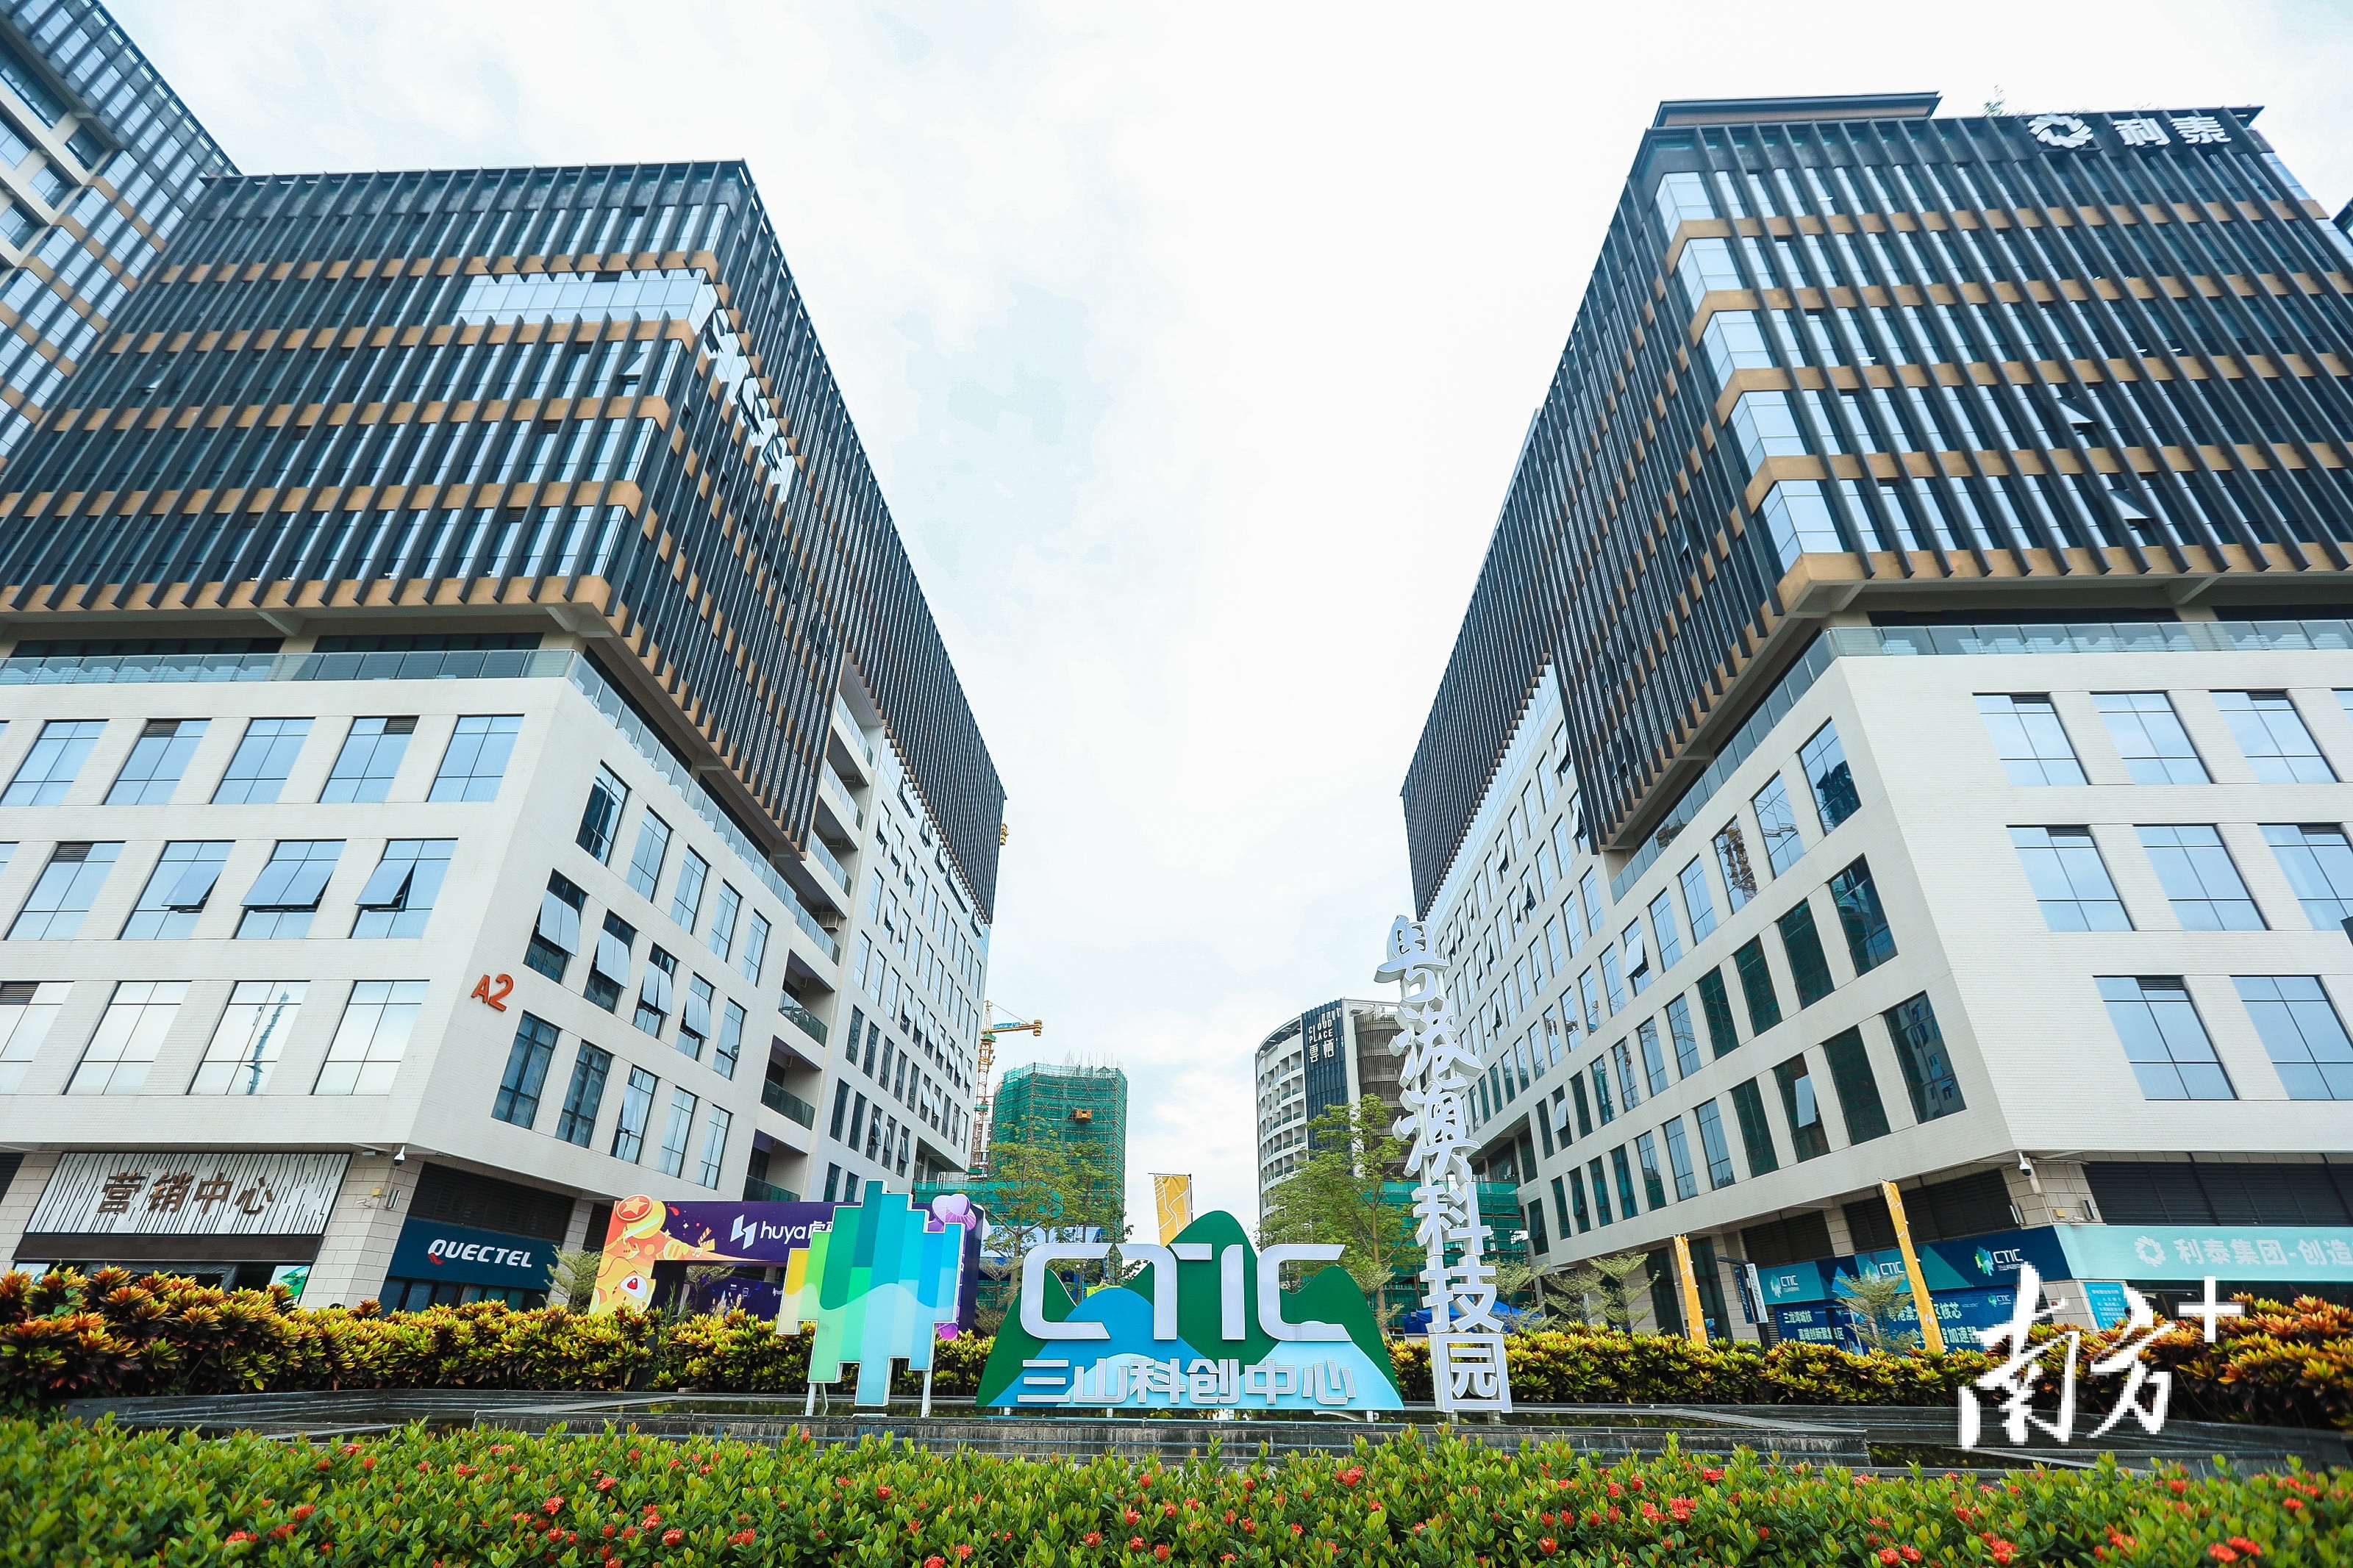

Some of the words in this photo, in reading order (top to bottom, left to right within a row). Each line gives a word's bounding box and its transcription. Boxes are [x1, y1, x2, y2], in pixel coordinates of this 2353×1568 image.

[2113, 115, 2232, 146] 利泰
[471, 973, 515, 1012] A2
[1309, 1028, 1334, 1044] PLACE
[1374, 914, 1513, 1414] 粤港澳科技园
[96, 1170, 273, 1215] 营销中心
[760, 1220, 807, 1245] huya
[428, 1239, 532, 1268] QUECTEL
[1993, 1248, 2024, 1264] CTIC
[1020, 1242, 1353, 1342] CTIC
[1017, 1358, 1357, 1405] 三山科创中心
